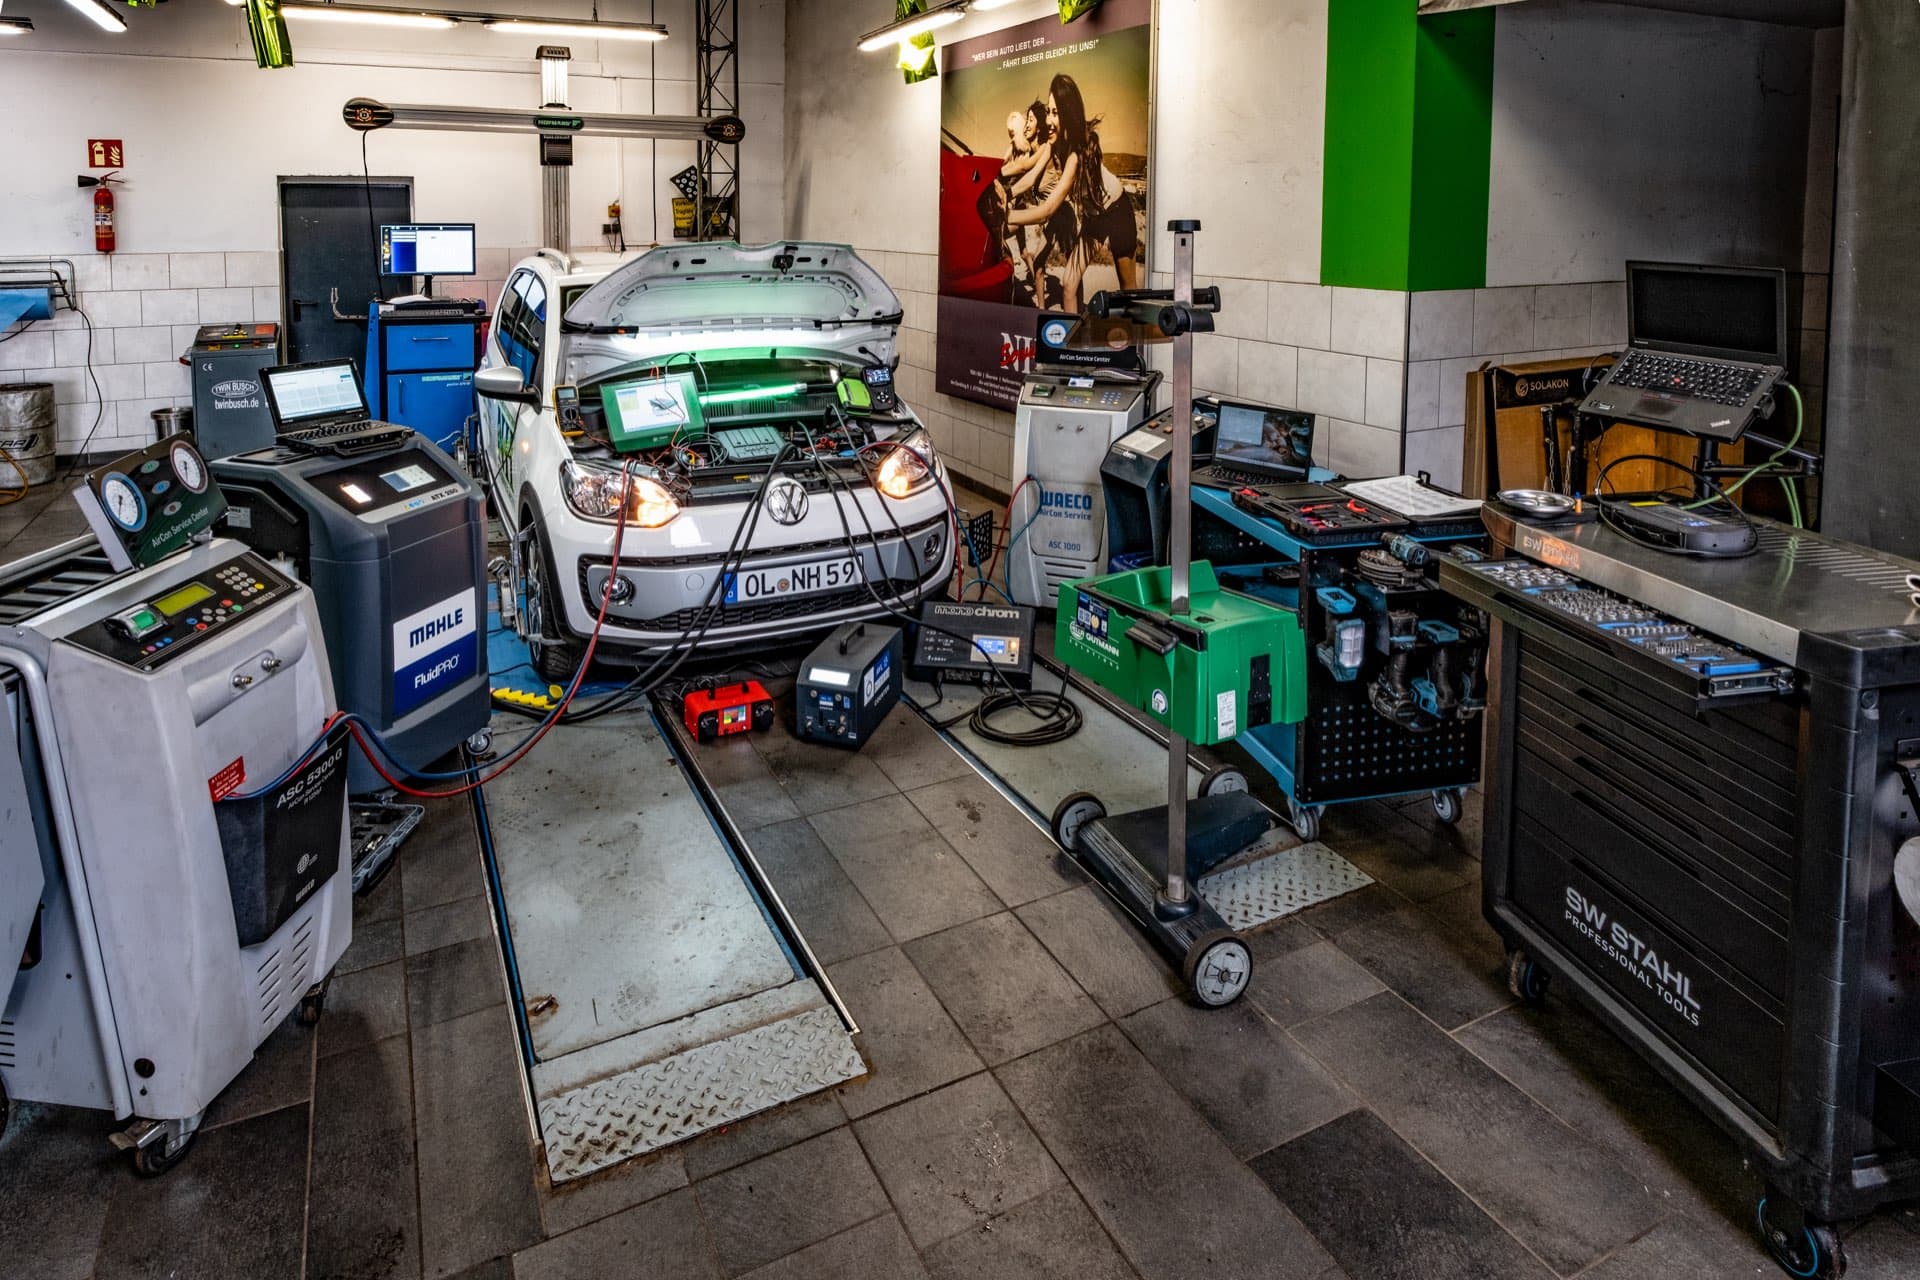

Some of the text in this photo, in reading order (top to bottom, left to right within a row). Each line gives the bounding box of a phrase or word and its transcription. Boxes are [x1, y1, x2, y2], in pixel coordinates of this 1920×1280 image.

[986, 48, 999, 60] SEIN
[1000, 45, 1015, 56] AUTO
[1032, 37, 1045, 48] DER
[1021, 51, 1044, 65] BESSER
[1045, 46, 1067, 60] GLEICH
[1068, 43, 1078, 54] ZU
[1060, 353, 1076, 361] AirCon
[1075, 354, 1094, 362] Service
[215, 382, 255, 395] TWIN BUSCH
[1530, 378, 1569, 391] SOLAKON
[214, 397, 260, 410] twinbusch.de
[1041, 490, 1093, 511] WAECO
[1041, 508, 1092, 521] AirCon Service
[151, 506, 210, 549] AirCon Service Center
[1048, 540, 1082, 552] ASC 1000
[745, 560, 856, 598] OL NH 59
[409, 607, 464, 649] MAHLE
[276, 780, 305, 809] ASC
[306, 756, 335, 786] 5300
[1566, 886, 1701, 1011] SW STAHL
[1565, 909, 1700, 1027] PROFESSIONAL TOOLS
